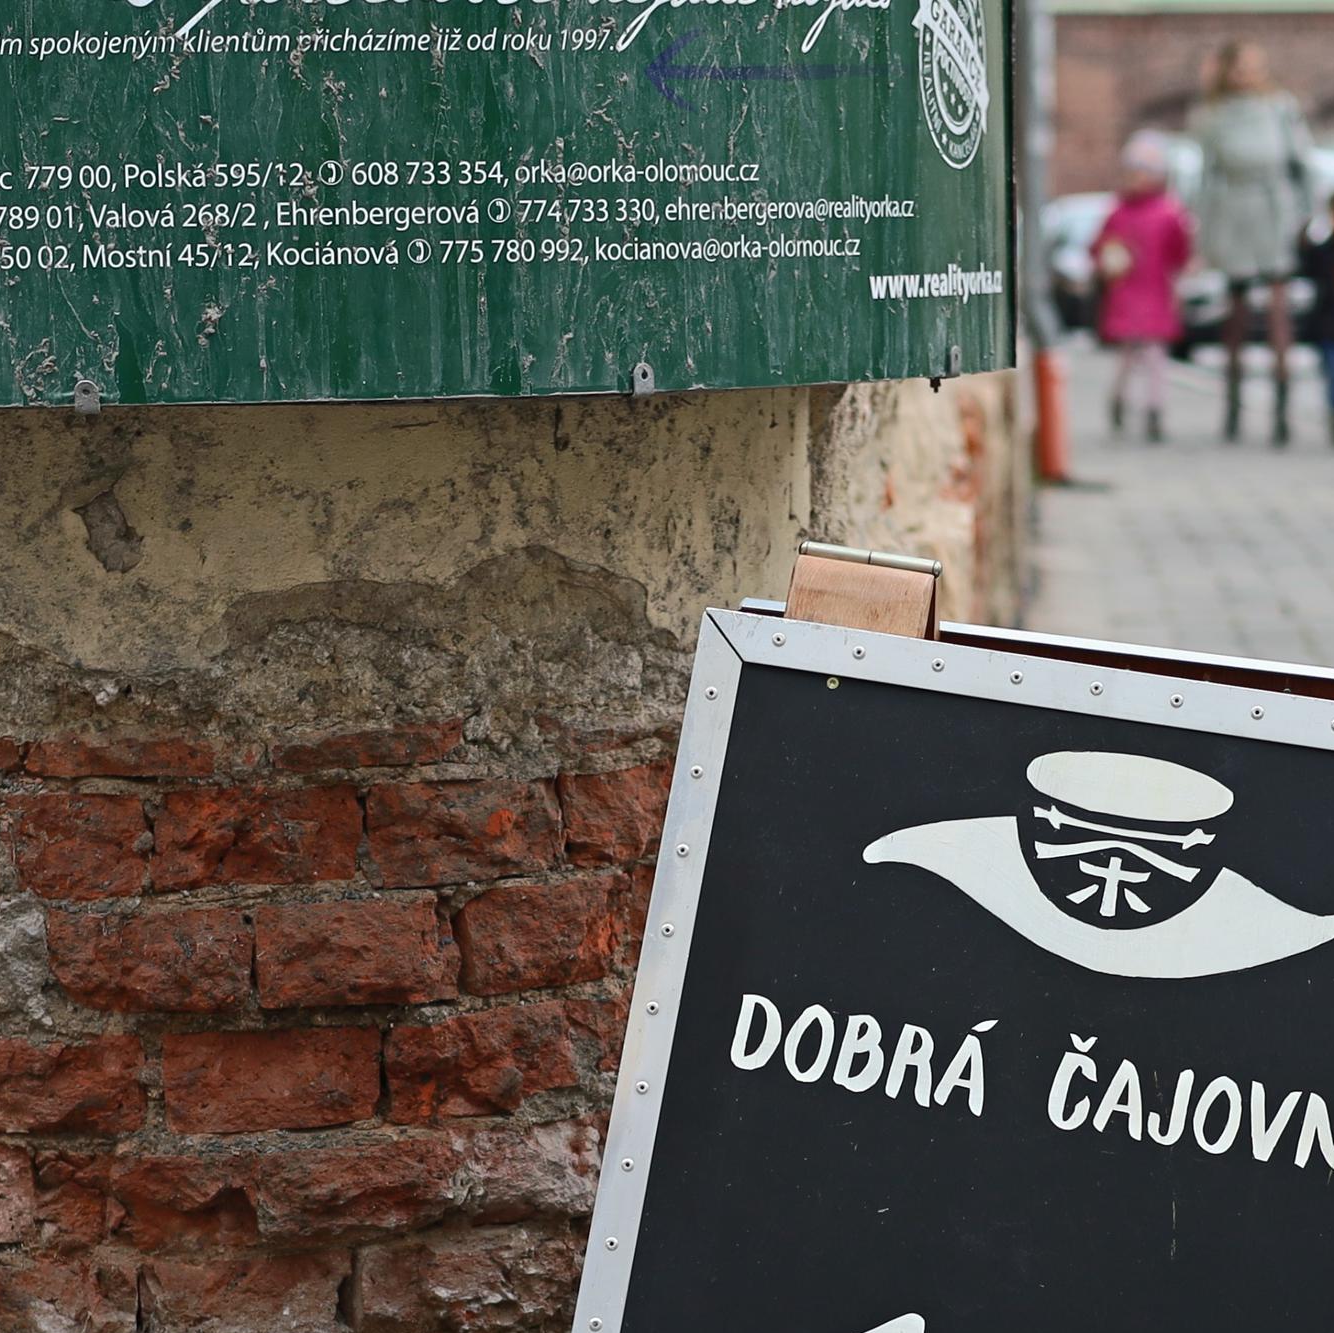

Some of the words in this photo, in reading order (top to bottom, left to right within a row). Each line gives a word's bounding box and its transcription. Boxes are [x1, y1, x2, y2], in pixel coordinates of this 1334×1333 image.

[29, 30, 175, 60] spokojeným
[183, 28, 290, 53] klientům
[296, 28, 430, 56] přicházíme
[433, 28, 462, 58] již
[467, 28, 496, 51] od
[502, 28, 551, 51] roku
[561, 28, 615, 52] 1997.
[25, 166, 71, 190] 779
[79, 165, 117, 192] 00,
[124, 162, 206, 188] Polská
[352, 162, 398, 186] 608
[406, 161, 451, 185] 733
[458, 161, 509, 188] 354,
[515, 159, 759, 186] orka@orka-olomouc.cz
[46, 205, 85, 233] 01,
[87, 203, 175, 228] Valová
[277, 199, 479, 230] Ehrenbergerová
[519, 200, 560, 223] 774
[566, 199, 608, 222] 733
[615, 198, 660, 225] 330,
[665, 196, 914, 225] ehrenbergerova@realityorka.cz
[37, 245, 76, 273] 02,
[82, 242, 171, 269] Mostní
[178, 242, 259, 271] 45/12,
[267, 240, 399, 267] Kociánová
[440, 240, 483, 264] 775
[491, 240, 535, 263] 780
[541, 239, 589, 266] 992,
[595, 234, 861, 263] kocianova@orka-olomouc.cz
[730, 994, 999, 1117] DOBRÁ
